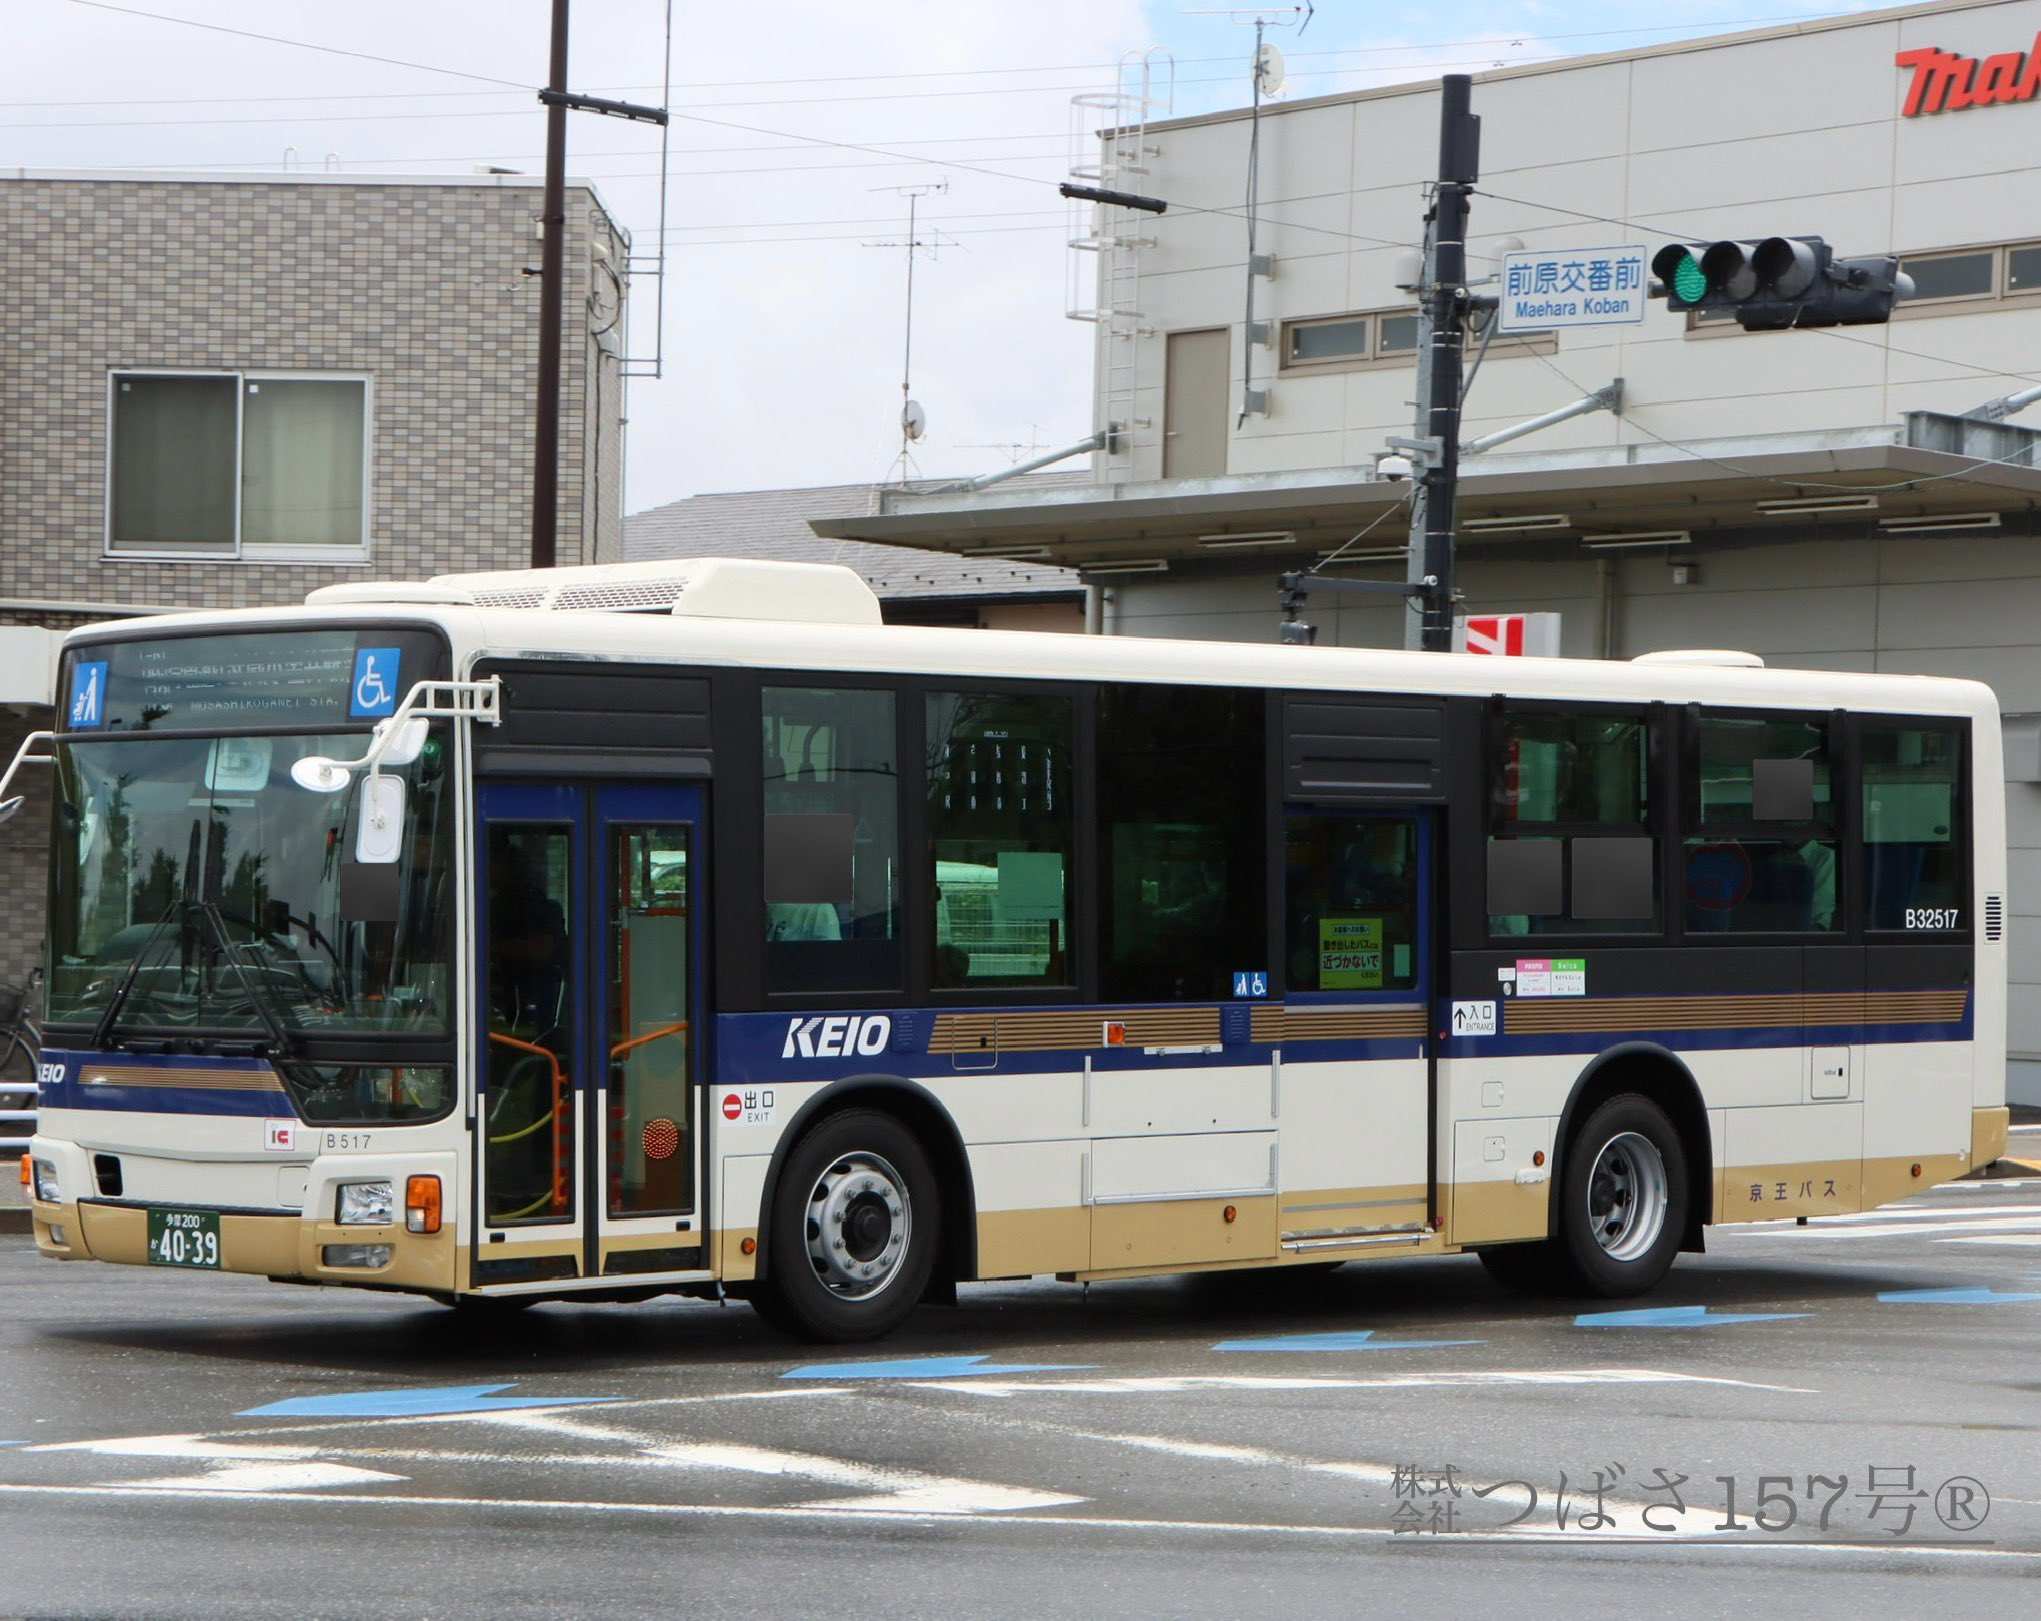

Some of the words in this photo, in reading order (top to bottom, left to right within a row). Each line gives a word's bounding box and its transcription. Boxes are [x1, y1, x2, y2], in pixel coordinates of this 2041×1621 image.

[1508, 256, 1641, 297] 前原交番前
[1515, 300, 1577, 318] Maehara
[1583, 298, 1630, 315] Koban
[1905, 908, 1959, 929] B32517
[1323, 954, 1379, 970] 近づかないで
[1557, 962, 1578, 970] Suica
[1469, 1005, 1492, 1020] 入口
[1466, 1022, 1495, 1032] ENTRANCE
[782, 1015, 891, 1059] KEIO
[744, 1090, 774, 1109] 出口
[747, 1112, 769, 1123] EXIT
[1749, 1180, 1836, 1203] 京王バス
[160, 1228, 217, 1265] 40-39
